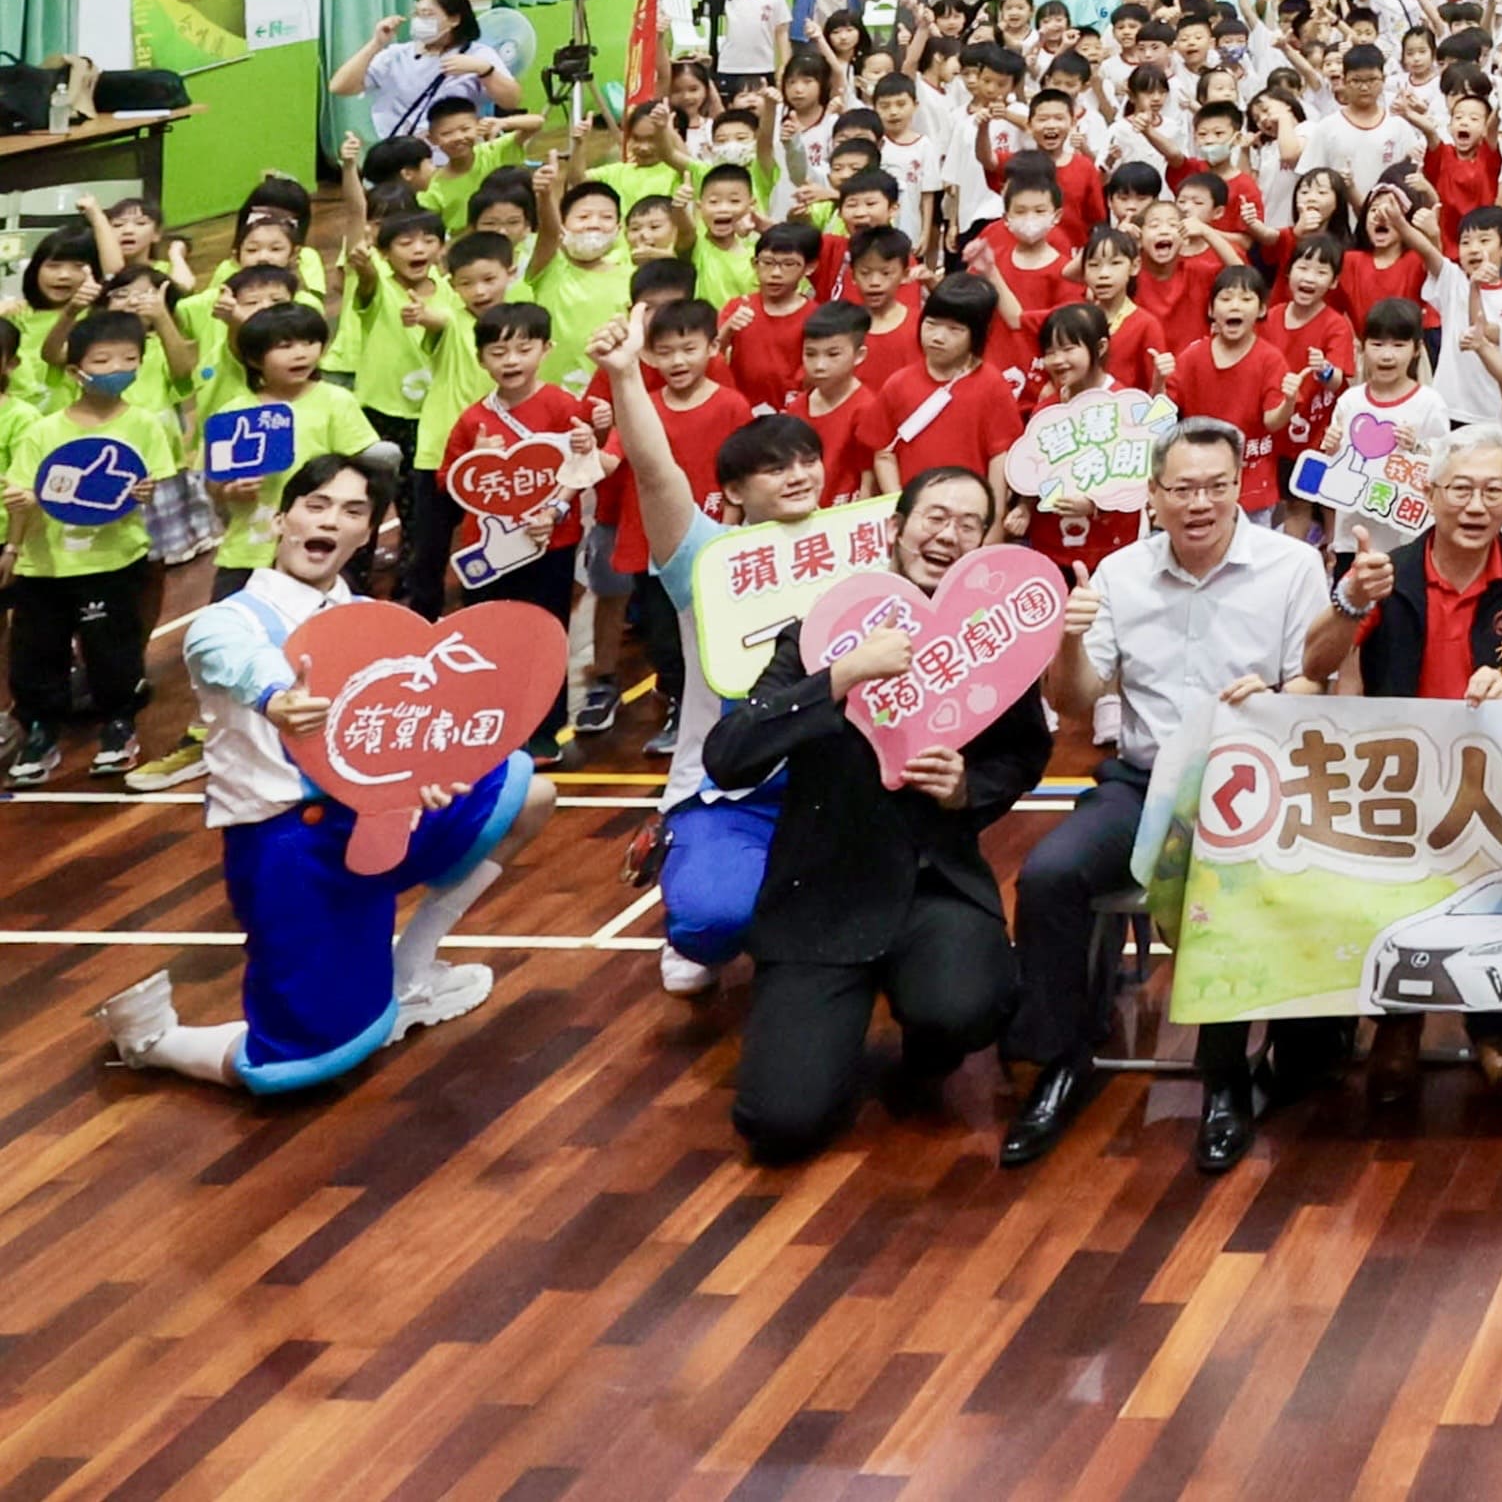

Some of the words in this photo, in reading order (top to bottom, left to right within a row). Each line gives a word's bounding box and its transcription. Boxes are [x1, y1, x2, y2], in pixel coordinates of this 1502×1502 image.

[1038, 403, 1118, 464] 智慧
[477, 466, 556, 505] 秀朗
[1071, 445, 1149, 492] 秀朗
[1365, 480, 1427, 529] 秀朗
[729, 520, 894, 594] 蘋果劇
[865, 581, 1057, 723] 蘋果劇團
[344, 703, 505, 755] 蘋果劇團
